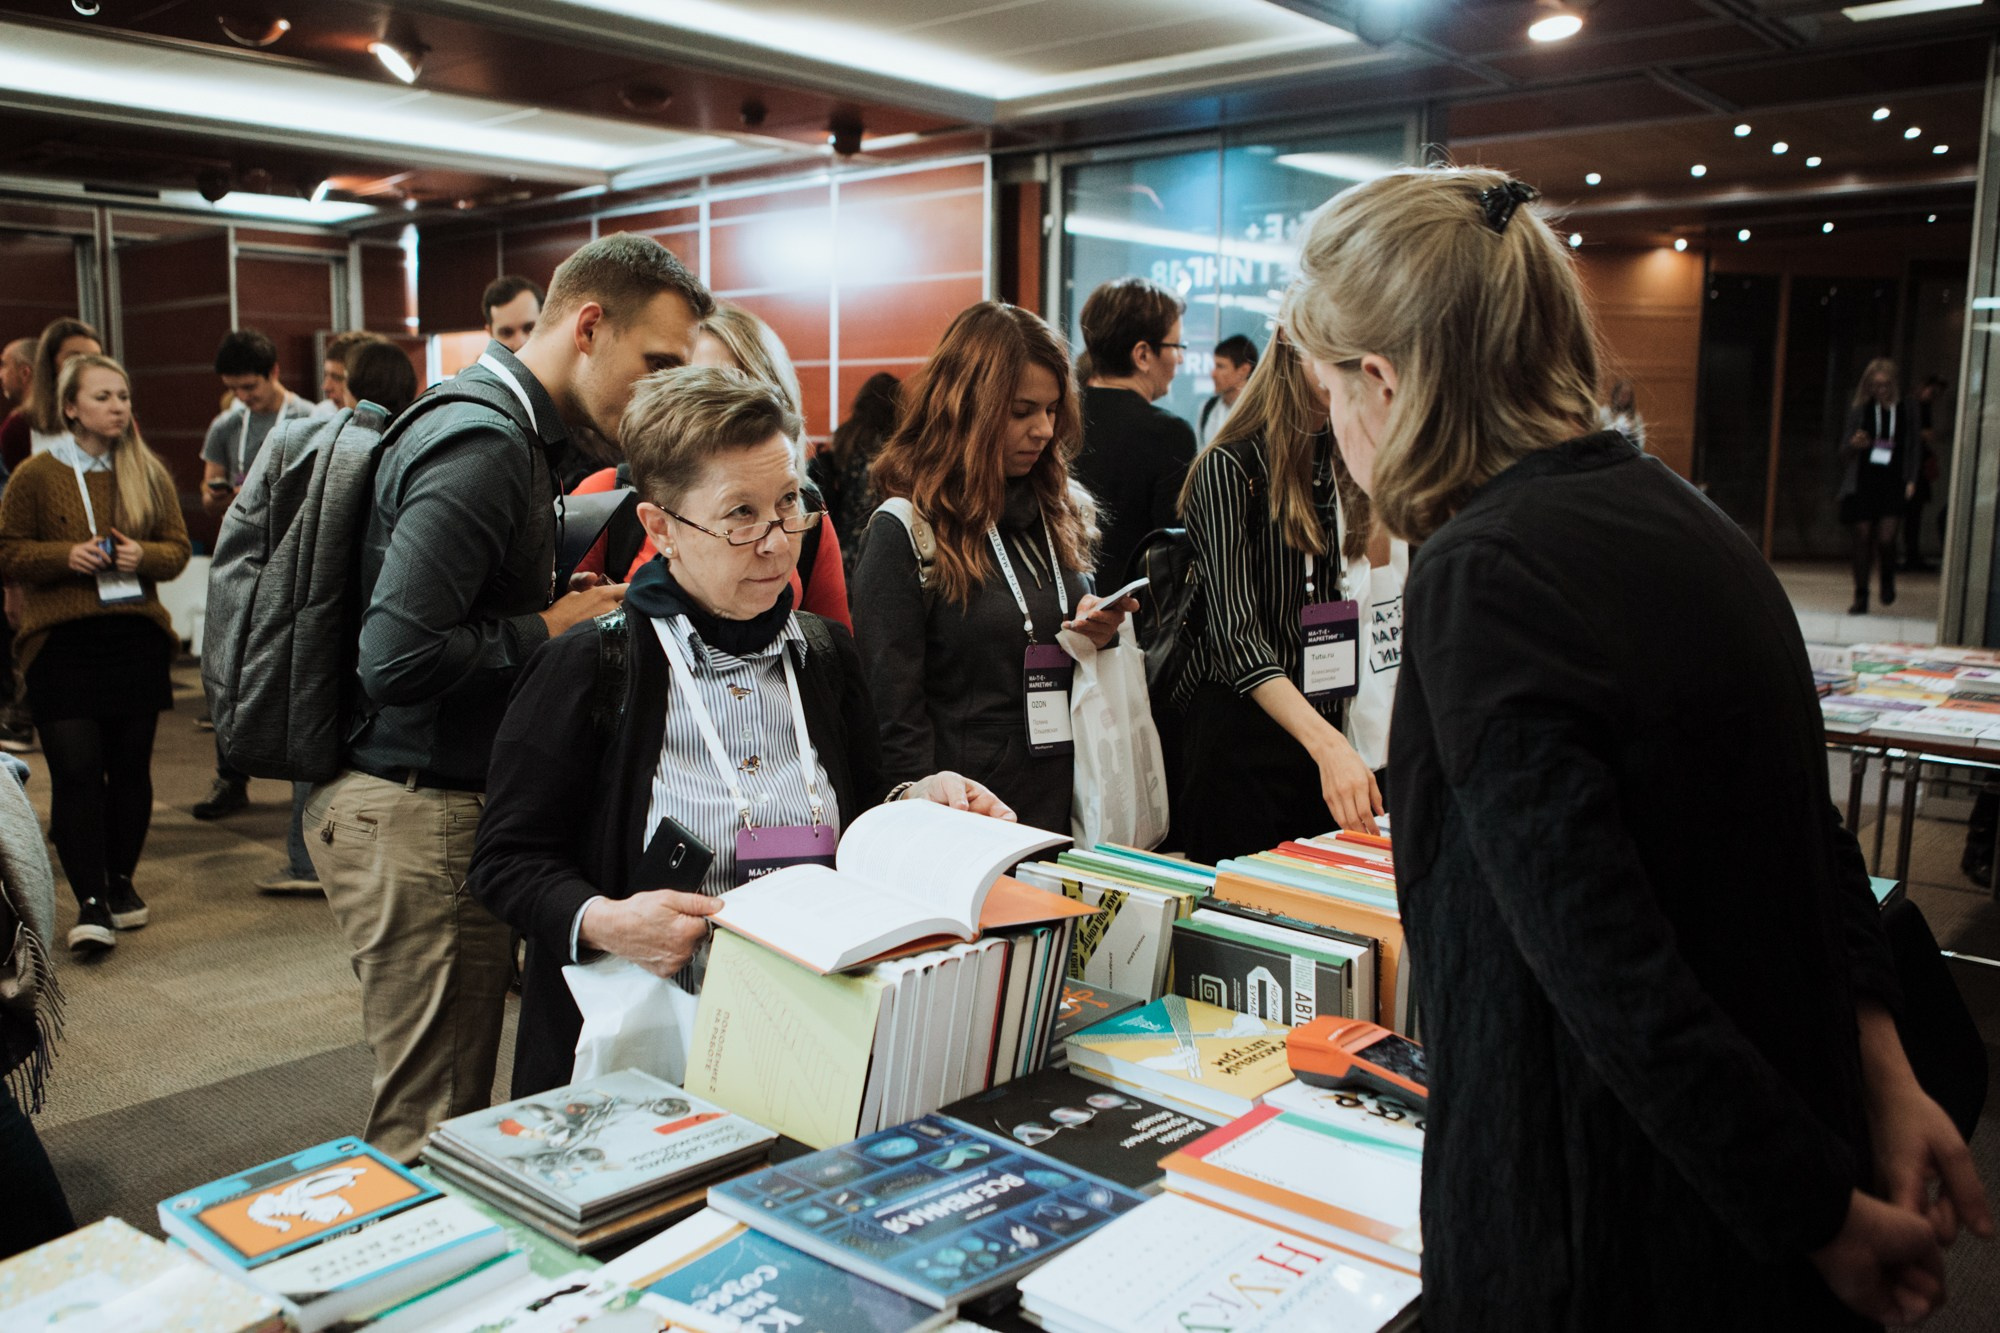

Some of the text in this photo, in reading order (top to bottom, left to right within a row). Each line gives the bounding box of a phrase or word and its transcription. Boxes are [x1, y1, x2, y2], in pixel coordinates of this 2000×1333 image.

[1311, 652, 1335, 661] Tutu.ru
[1031, 700, 1047, 709] OZON
[882, 1173, 1026, 1234] ВСЕЛЕННАЯ
